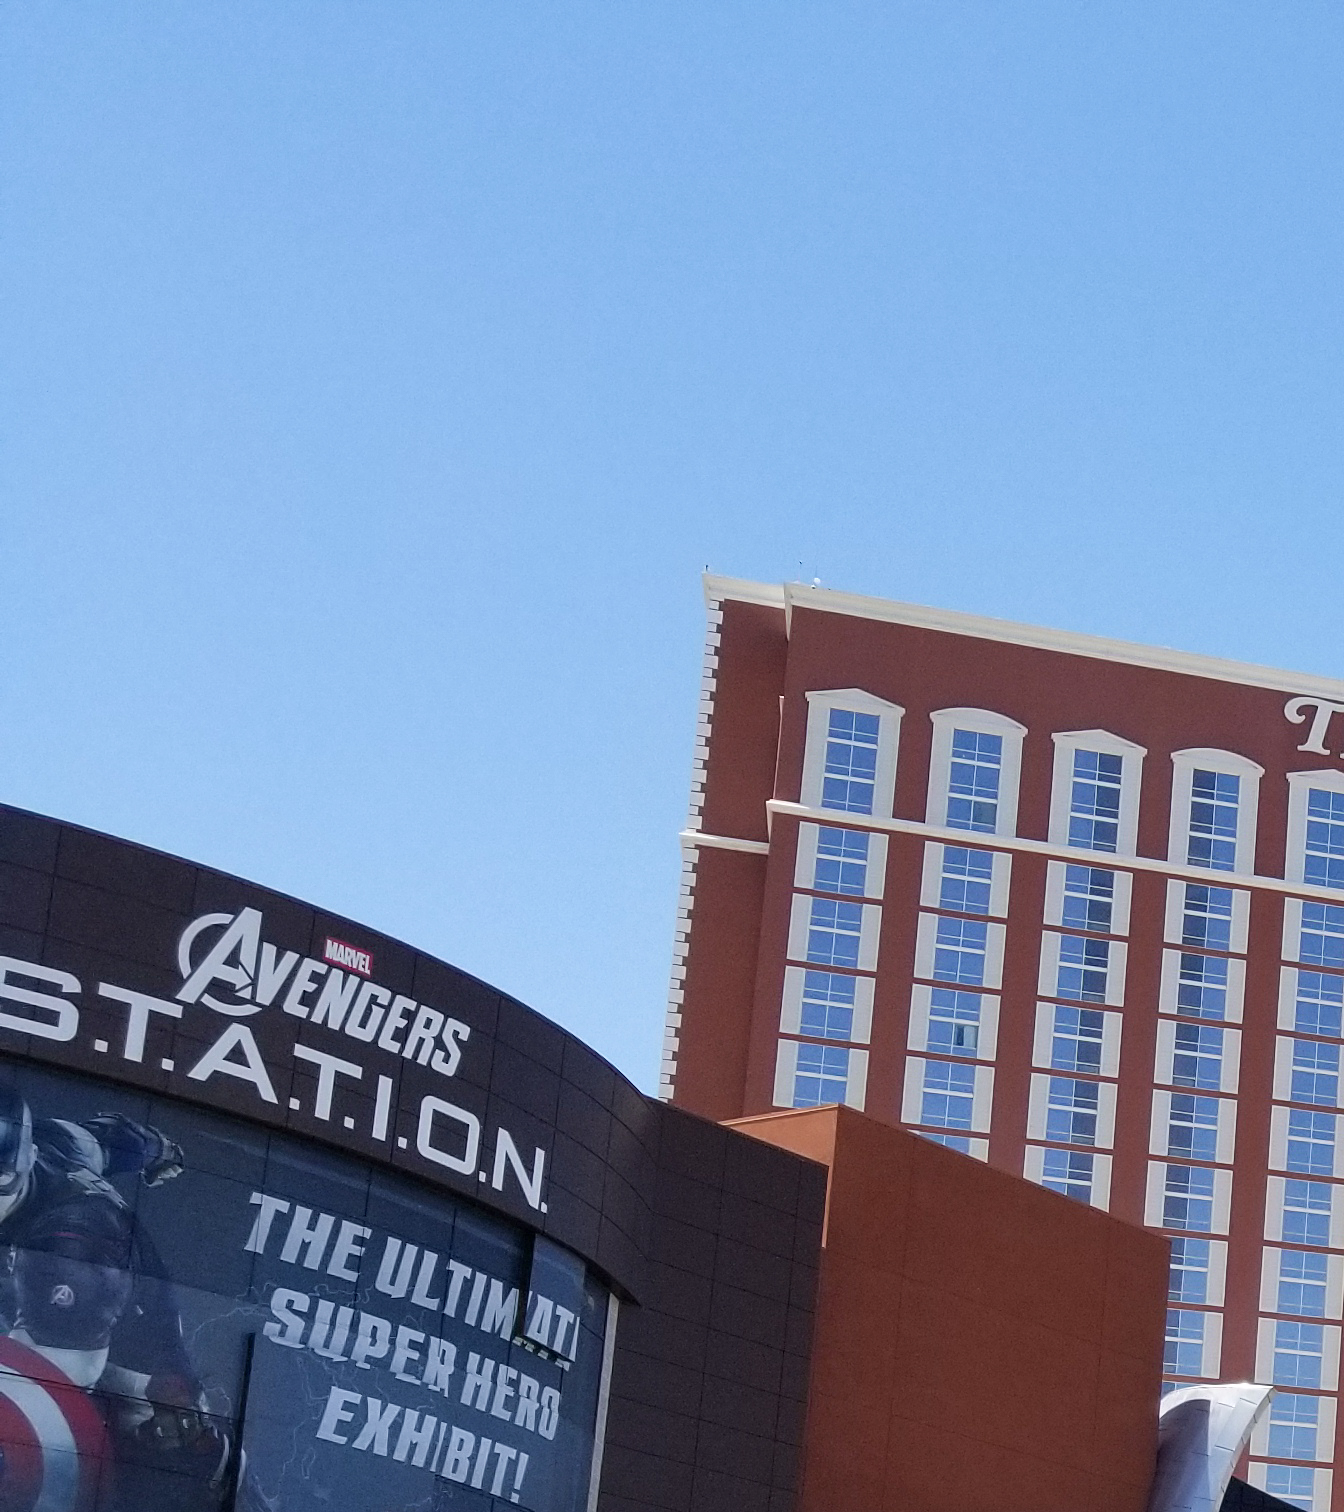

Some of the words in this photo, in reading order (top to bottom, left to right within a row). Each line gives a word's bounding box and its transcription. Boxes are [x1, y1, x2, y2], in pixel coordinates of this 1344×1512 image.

[175, 906, 470, 1077] AVENGERS
[325, 938, 370, 976] MARVEL
[244, 1191, 372, 1283] THE
[375, 1235, 580, 1368] ULTIMAT
[263, 1287, 458, 1398] SUPER
[460, 1351, 561, 1441] HERO
[316, 1385, 529, 1504] EXHIBIT!
